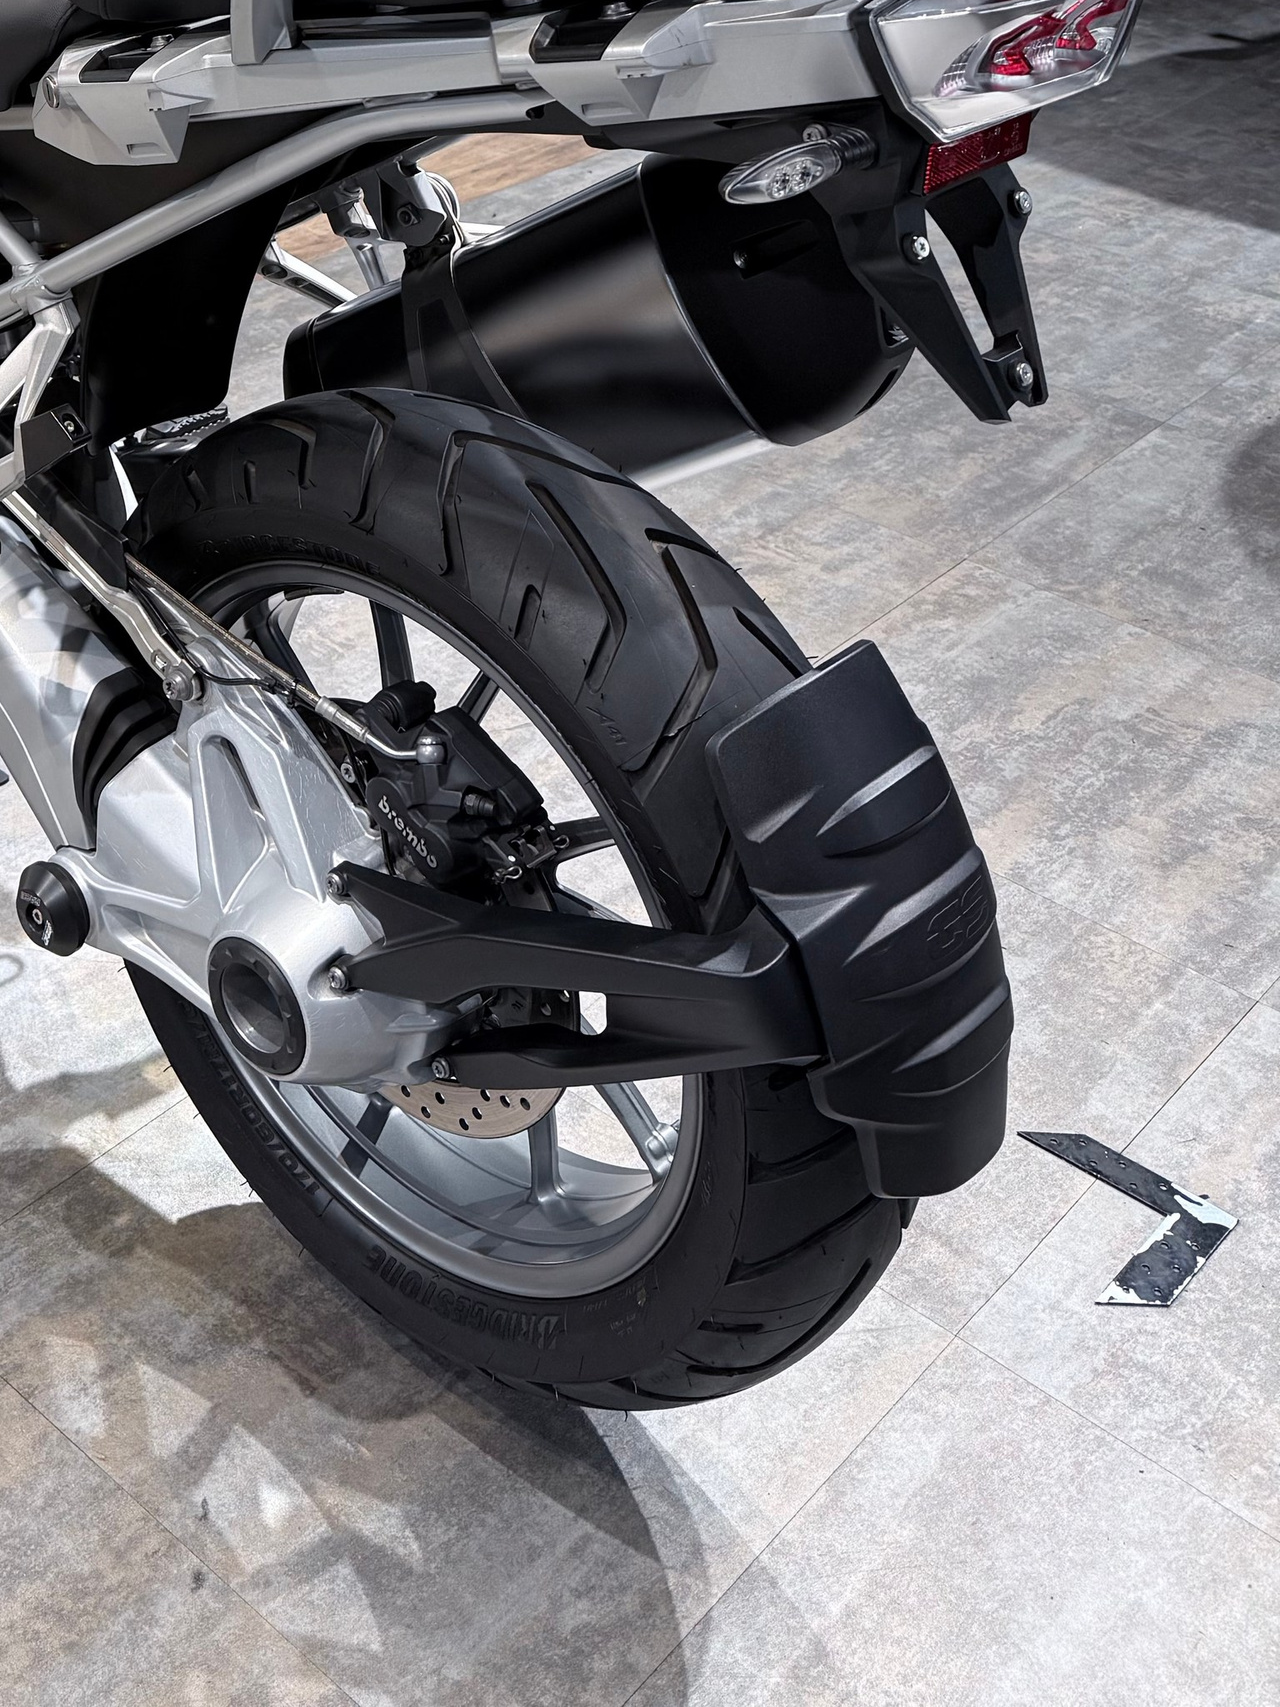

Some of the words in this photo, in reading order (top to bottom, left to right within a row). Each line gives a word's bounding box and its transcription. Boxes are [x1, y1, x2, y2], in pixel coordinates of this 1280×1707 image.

[378, 795, 438, 869] brembo
[926, 875, 990, 961] GS
[362, 1245, 562, 1351] BRIDGESTONE
